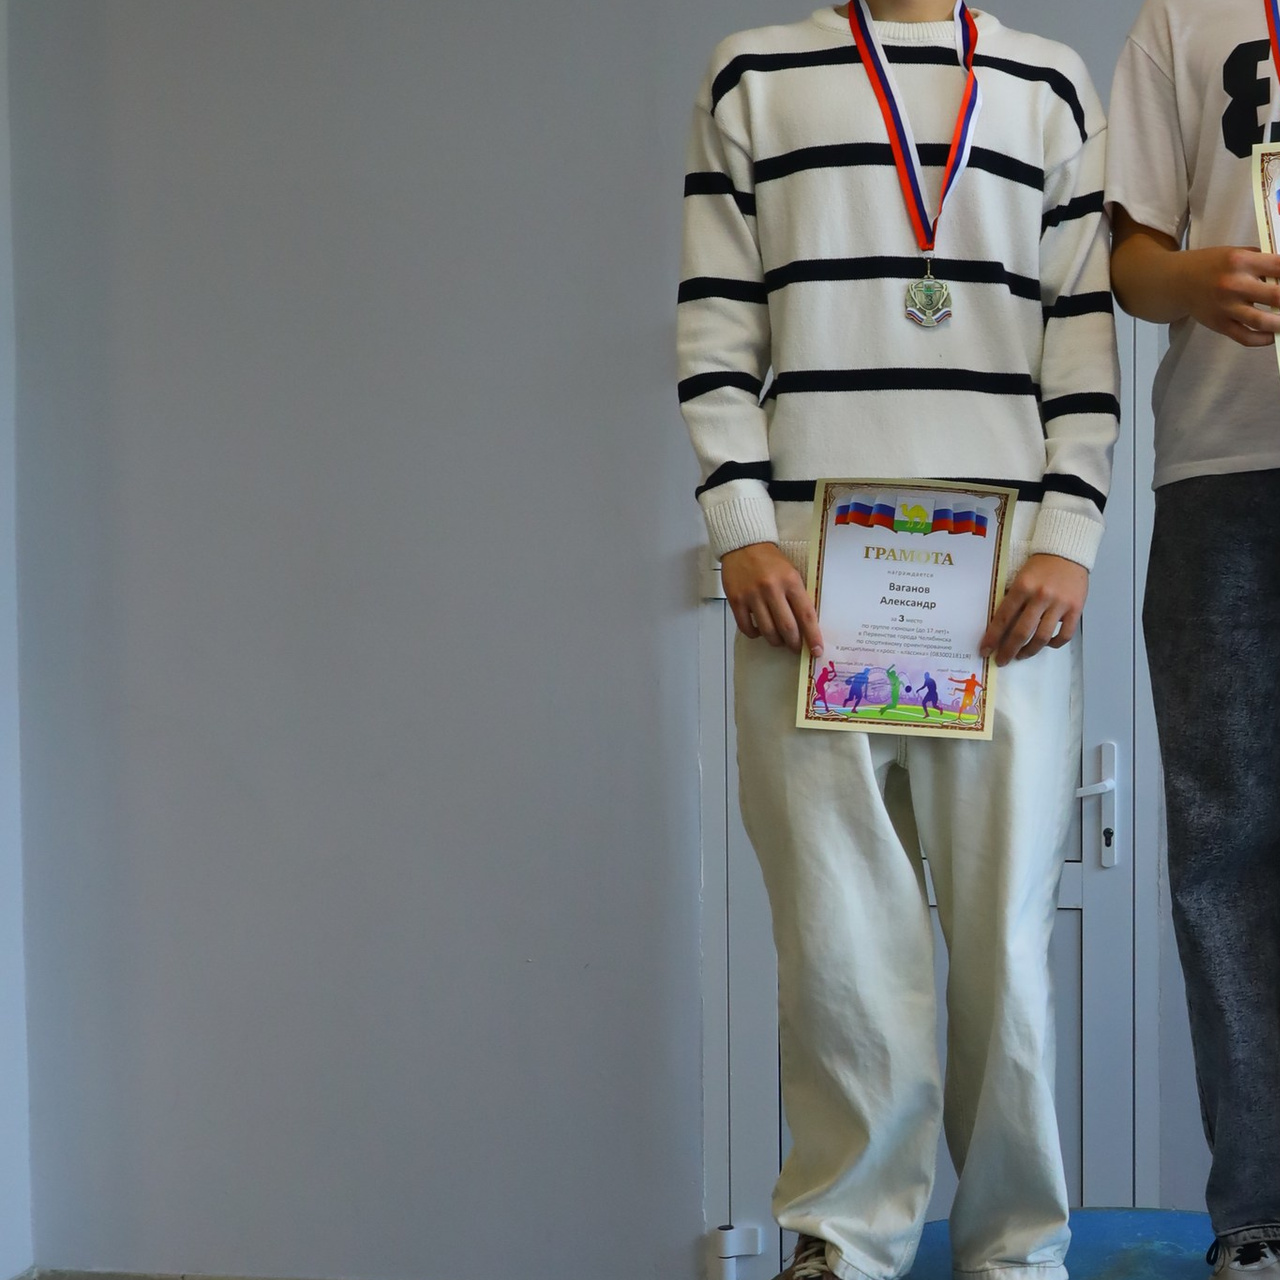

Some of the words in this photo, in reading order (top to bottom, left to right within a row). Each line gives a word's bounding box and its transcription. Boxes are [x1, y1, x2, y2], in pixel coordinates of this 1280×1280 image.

[864, 545, 954, 566] ГРАМОТА
[887, 569, 934, 578] награждается
[888, 582, 930, 594] Ваганов
[880, 596, 937, 610] Александр
[898, 614, 905, 623] 3
